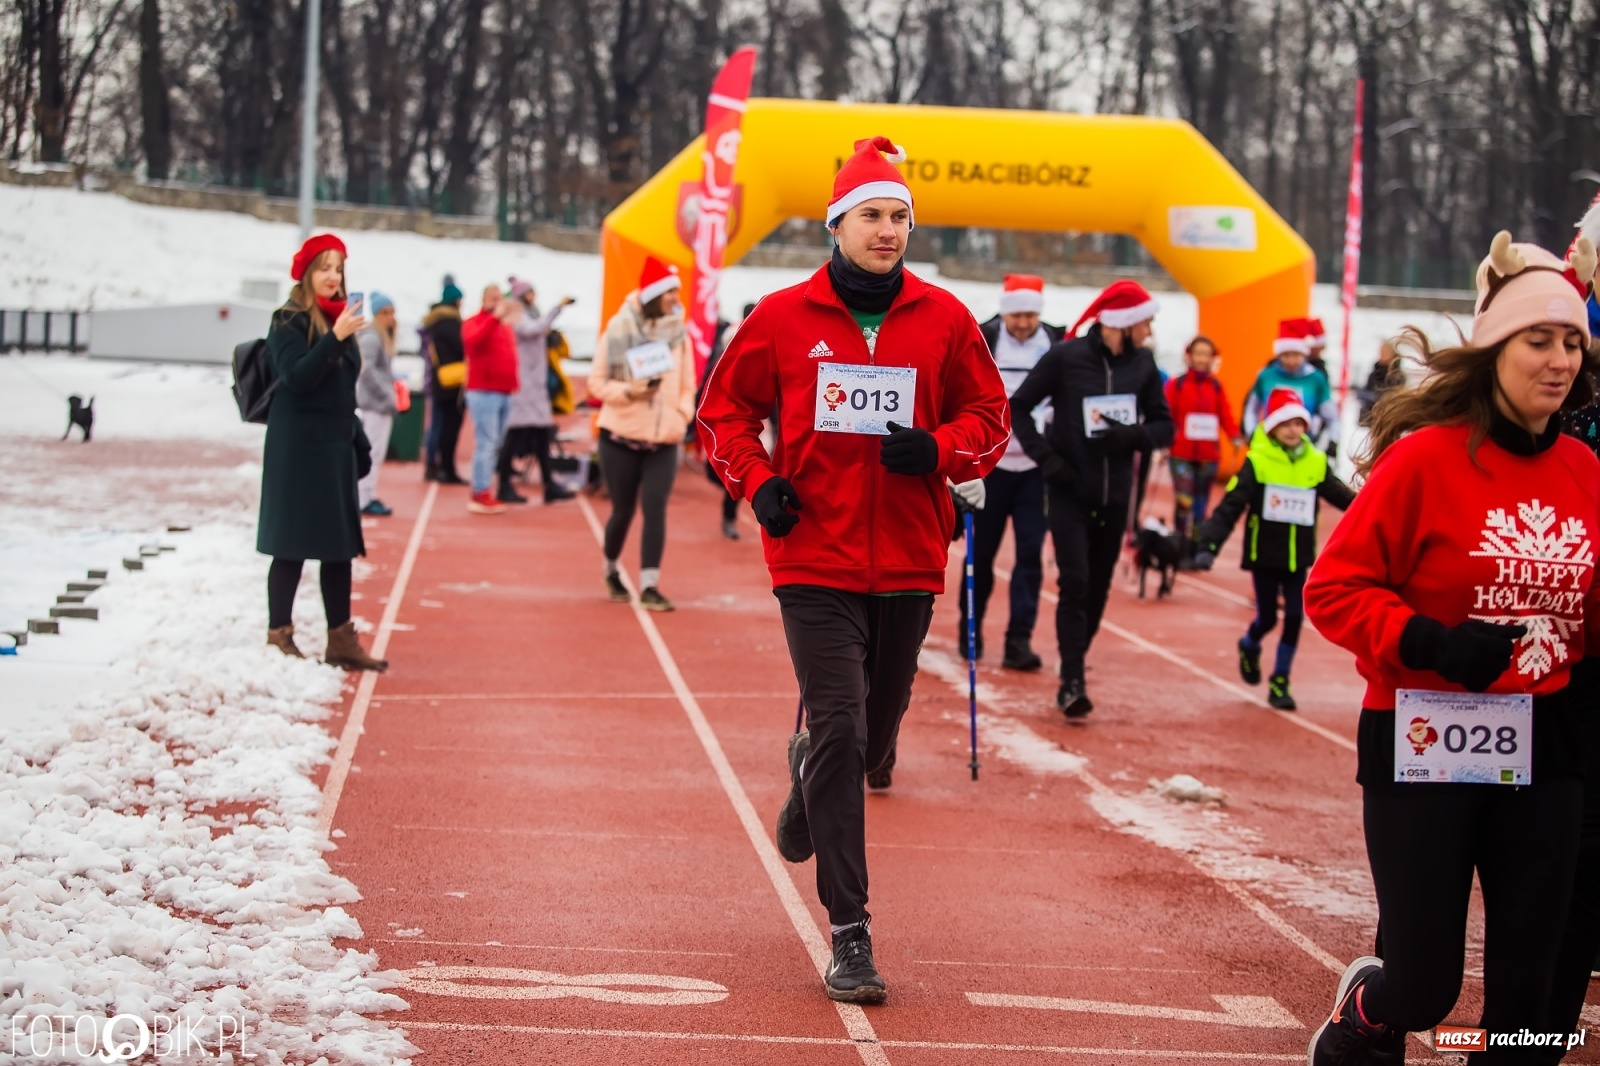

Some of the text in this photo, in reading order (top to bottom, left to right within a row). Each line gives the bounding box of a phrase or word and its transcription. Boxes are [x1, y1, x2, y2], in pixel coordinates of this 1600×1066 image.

[949, 160, 1092, 188] RACIBÓRZ
[808, 350, 834, 358] adidas
[850, 388, 900, 413] 013
[1284, 498, 1307, 513] 177
[1495, 558, 1587, 589] HAPPY
[1443, 724, 1518, 755] 028
